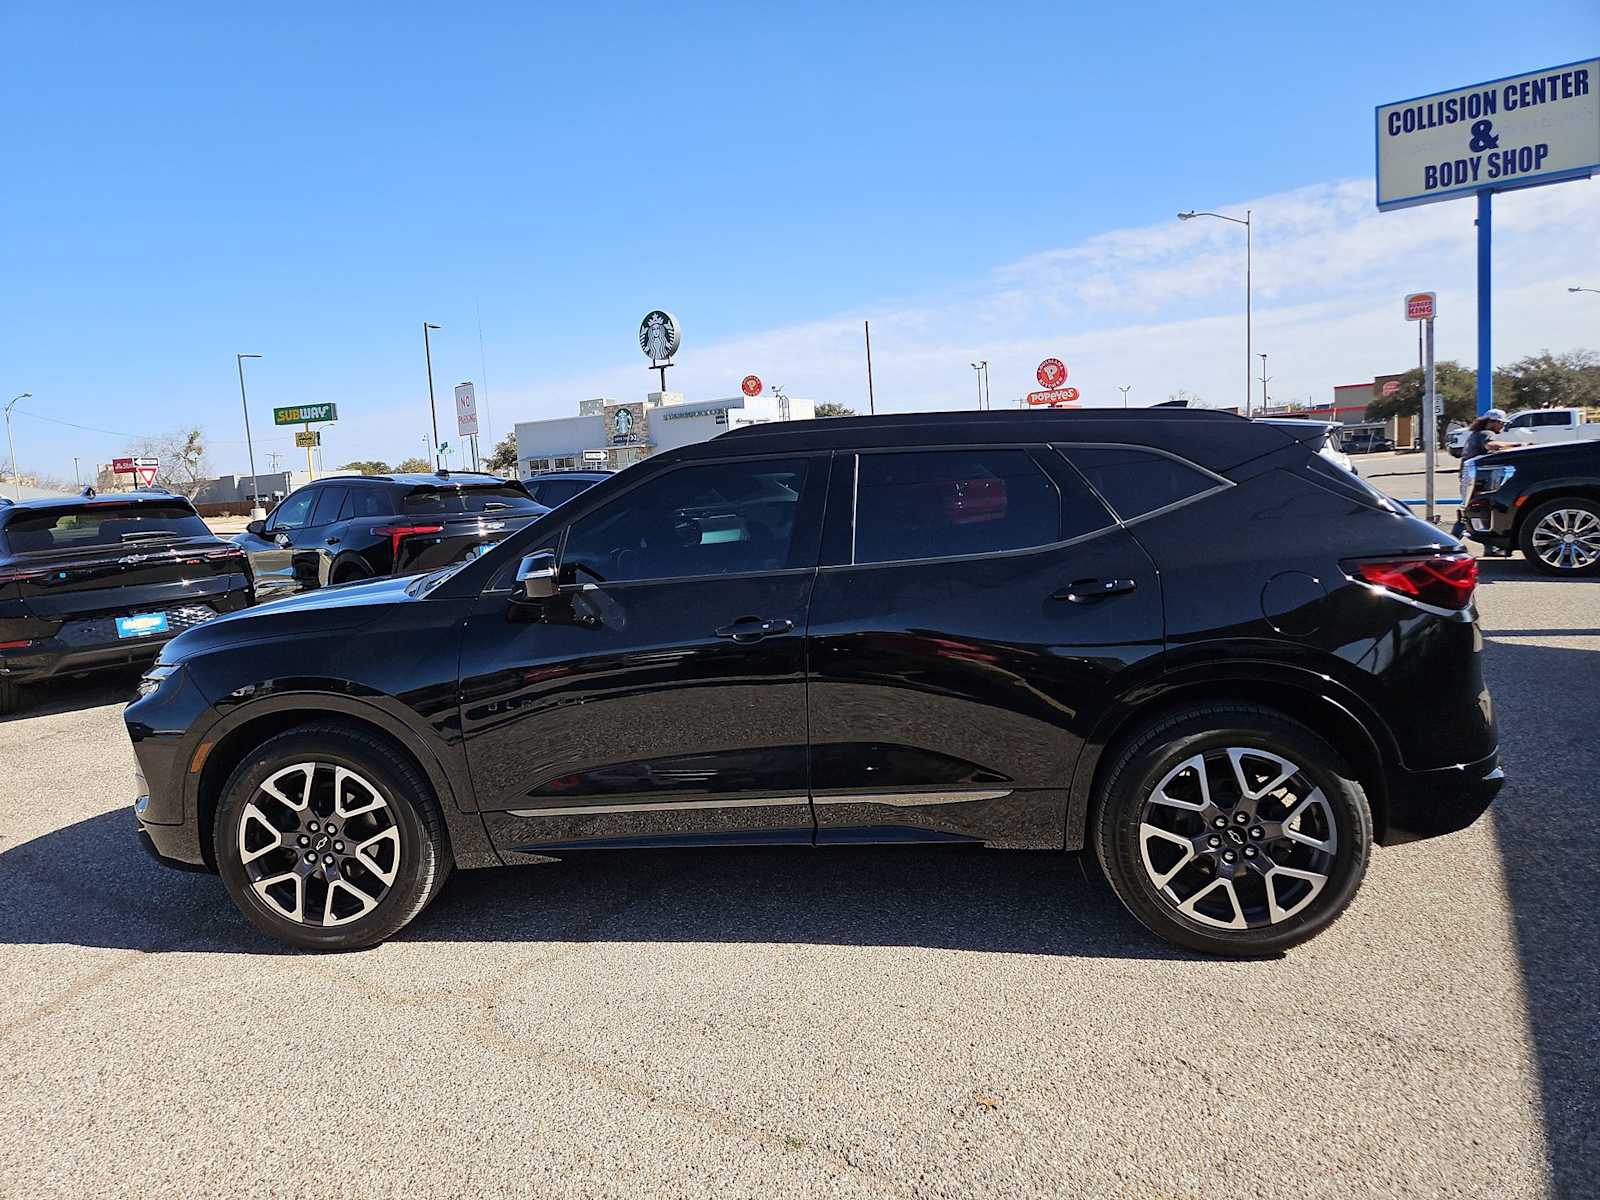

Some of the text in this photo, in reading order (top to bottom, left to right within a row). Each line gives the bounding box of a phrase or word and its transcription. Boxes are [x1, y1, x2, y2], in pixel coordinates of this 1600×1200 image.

[1388, 69, 1589, 137] COLLISION CENTER
[1469, 119, 1500, 153] &
[1424, 143, 1549, 190] BODY SHOP
[1408, 305, 1433, 315] KING
[277, 406, 327, 422] SUBWAY
